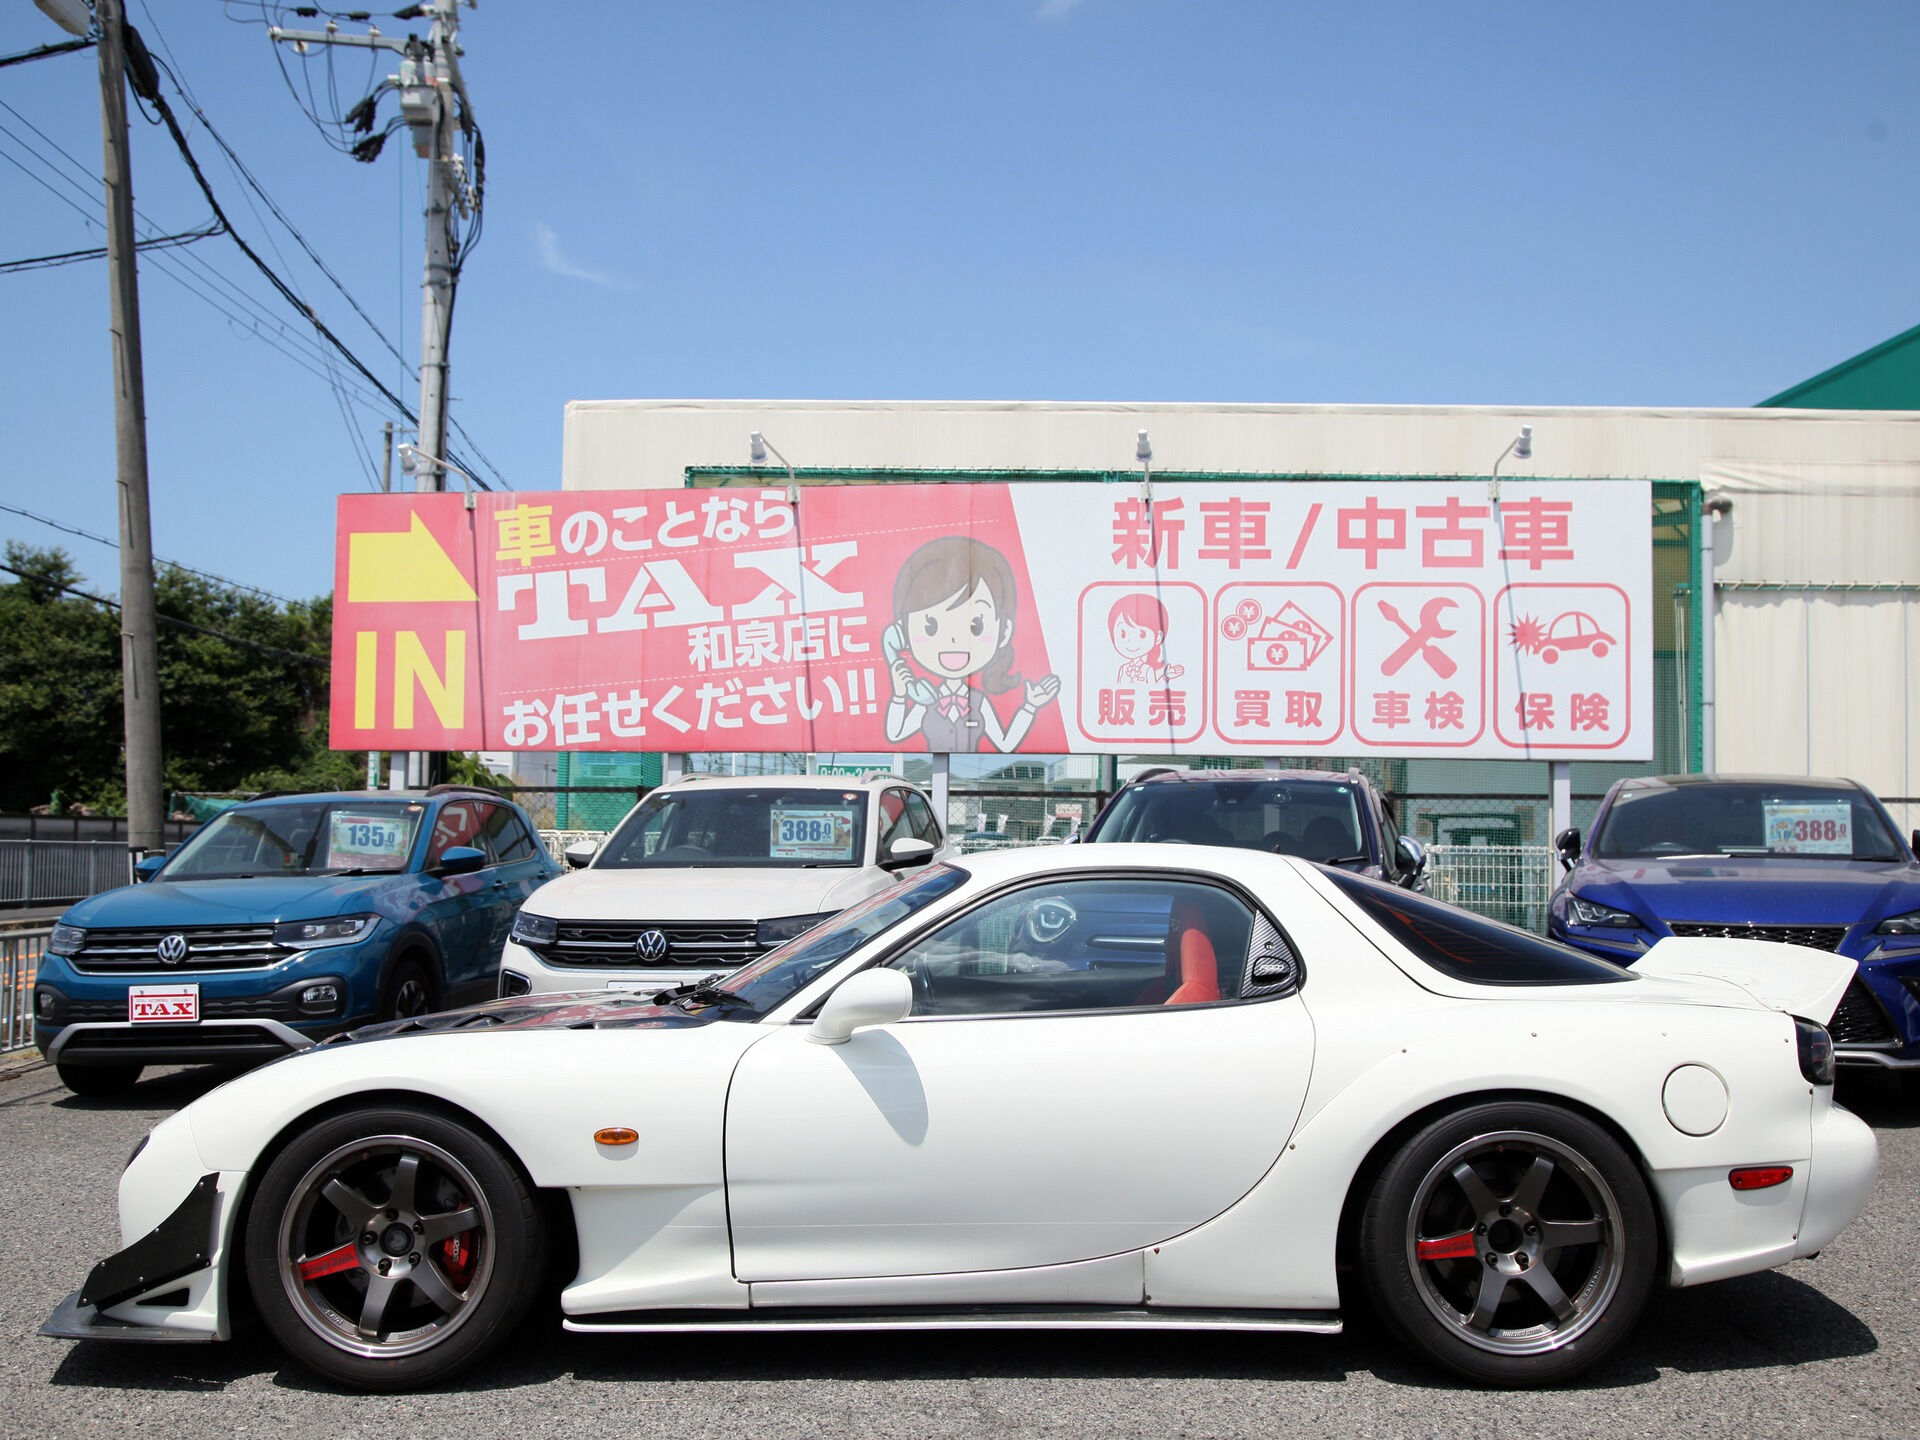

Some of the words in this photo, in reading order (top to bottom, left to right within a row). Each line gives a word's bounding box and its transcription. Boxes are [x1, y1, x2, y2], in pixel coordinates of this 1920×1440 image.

[495, 490, 796, 567] 車のことなら
[1112, 496, 1575, 571] 新車/中古車
[497, 541, 865, 641] TAX
[688, 615, 870, 672] 和泉店に
[354, 630, 466, 730] IN
[503, 669, 877, 746] お任せください!!
[1098, 689, 1187, 726] 販売
[1234, 690, 1323, 727] 買取
[1372, 690, 1465, 730] 車検
[1515, 692, 1610, 732] 保険
[782, 820, 832, 842] 388.0
[1795, 820, 1847, 841] 388.0
[135, 1003, 193, 1016] TAX
